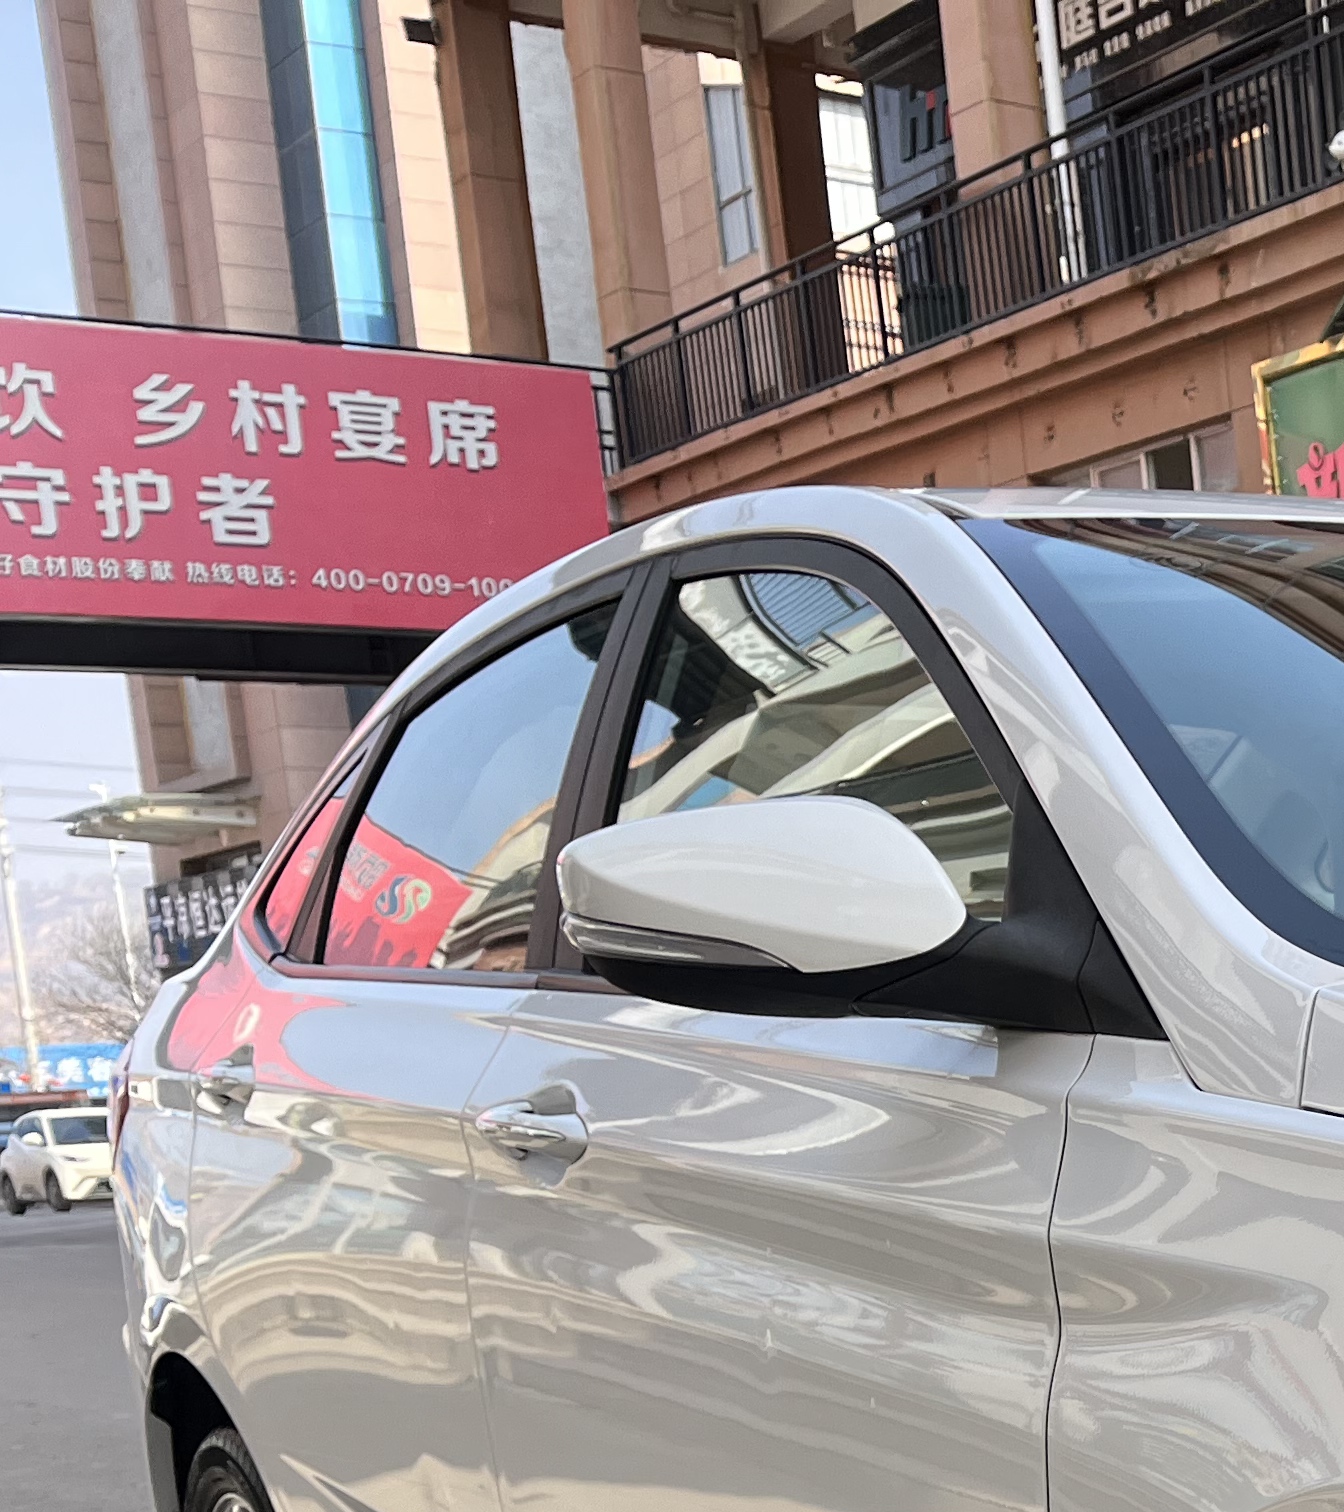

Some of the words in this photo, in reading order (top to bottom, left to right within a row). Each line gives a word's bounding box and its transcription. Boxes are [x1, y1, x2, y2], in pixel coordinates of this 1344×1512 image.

[133, 373, 500, 472] 乡村宴席
[0, 461, 275, 546] 守护者
